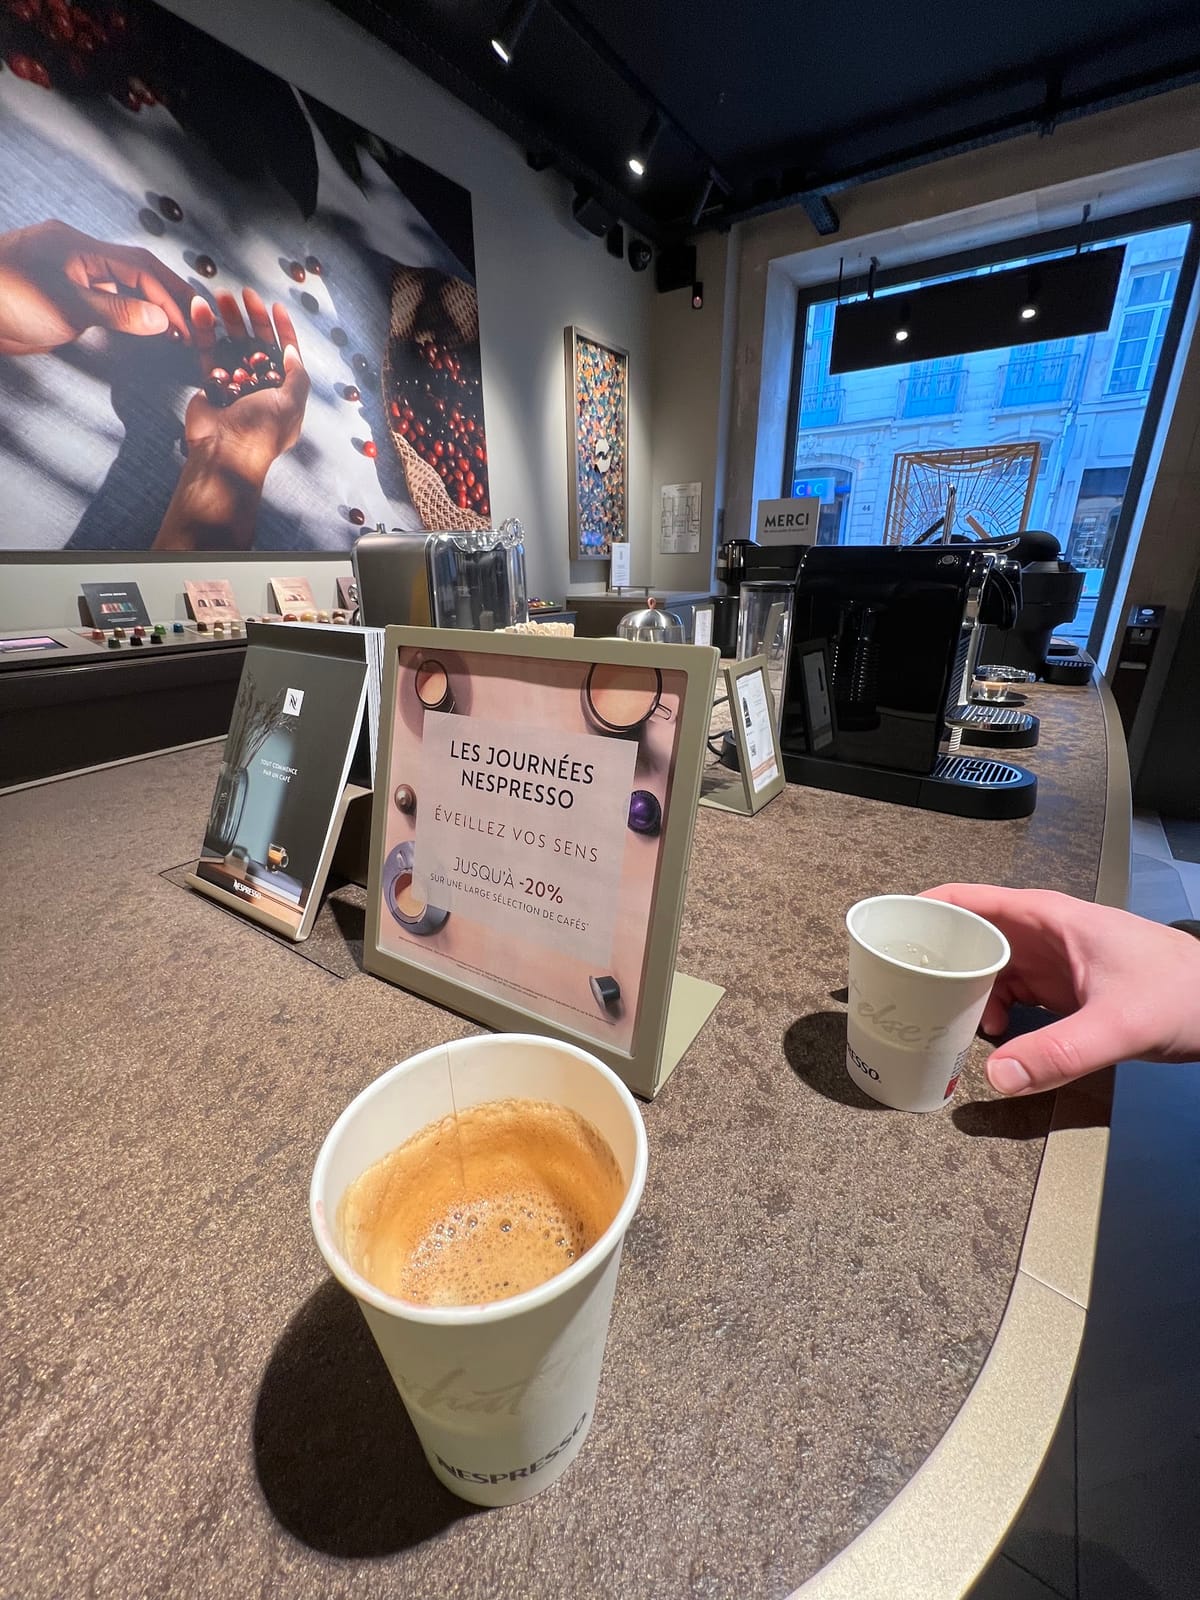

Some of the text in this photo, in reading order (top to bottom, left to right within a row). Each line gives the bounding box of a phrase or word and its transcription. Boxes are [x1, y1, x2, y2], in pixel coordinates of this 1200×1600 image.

[764, 512, 810, 528] MERCI
[450, 740, 594, 785] LES JOURNÉES
[461, 769, 574, 809] NESPRESSO
[434, 804, 598, 863] ÉVEILLEZ VOS SENS
[233, 879, 262, 899] NESPRESSO
[430, 872, 446, 884] SUR
[446, 878, 463, 891] UNE
[464, 882, 491, 900] LARGE
[493, 892, 541, 916] SÉLECTION
[542, 908, 555, 921] DE
[519, 877, 564, 904] -20%
[433, 1412, 587, 1484] NESPRESSO
